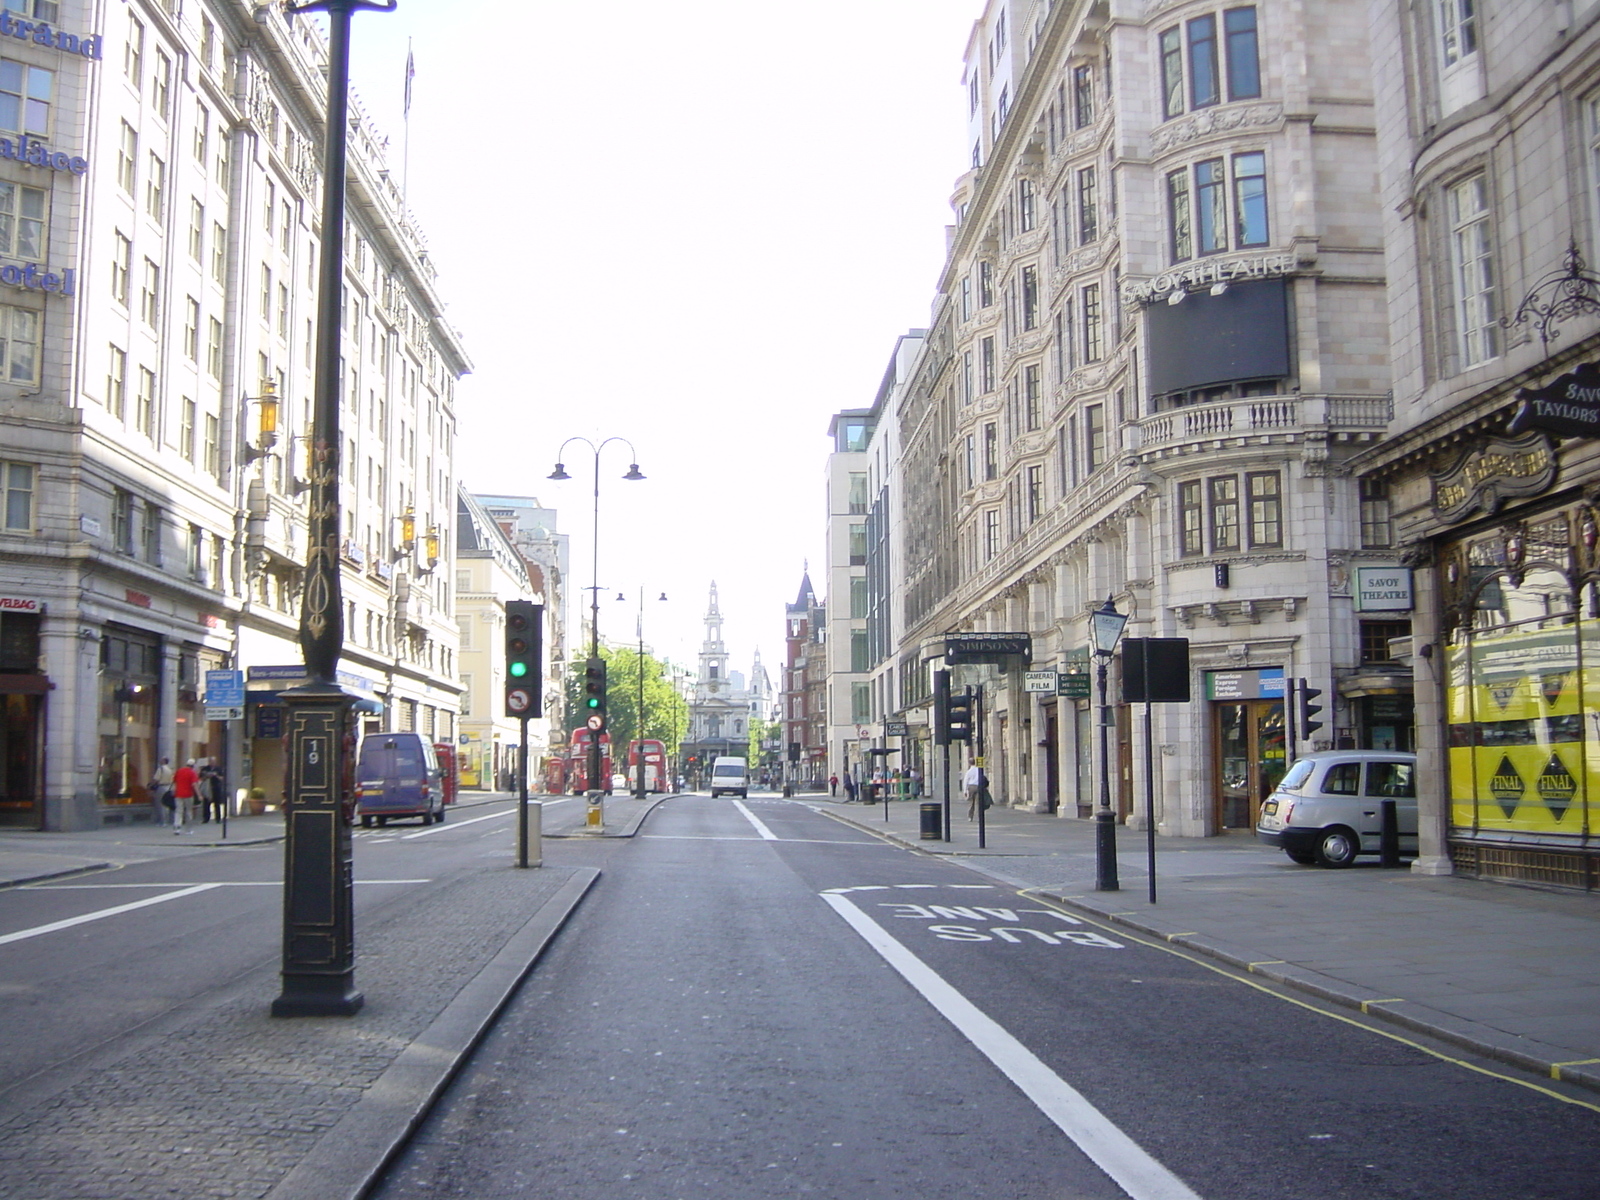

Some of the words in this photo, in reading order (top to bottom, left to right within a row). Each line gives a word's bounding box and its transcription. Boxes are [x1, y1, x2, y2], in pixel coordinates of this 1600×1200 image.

[1191, 253, 1298, 286] THEATRE
[1368, 578, 1399, 587] SAVOY
[1361, 590, 1408, 600] THEATRE
[960, 641, 1019, 651] SIMPSON'S
[1031, 682, 1050, 690] FILM
[1494, 776, 1521, 790] FINAL
[1541, 775, 1572, 790] FINAL
[877, 903, 1082, 925] LANE
[928, 925, 1125, 949] BUS
